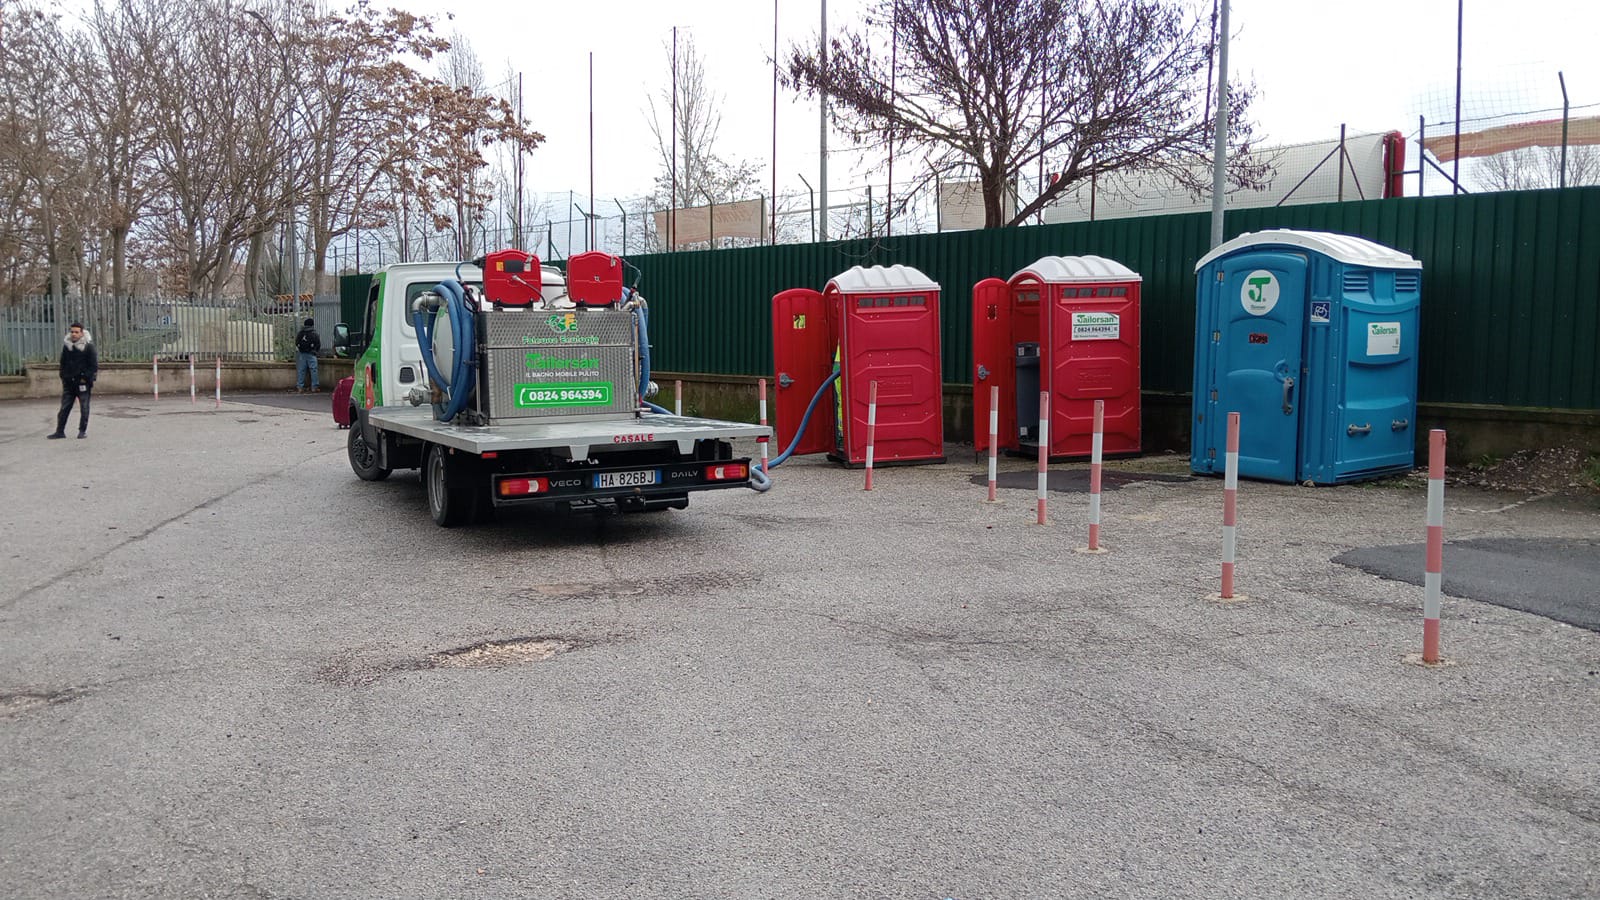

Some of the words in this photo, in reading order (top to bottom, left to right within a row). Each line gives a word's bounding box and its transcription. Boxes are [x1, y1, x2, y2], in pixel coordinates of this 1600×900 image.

[1077, 315, 1114, 323] Tailorsan
[525, 353, 599, 369] Tailorsan
[529, 391, 559, 401] 0824
[561, 390, 602, 400] 964394
[613, 434, 654, 444] CASALE
[601, 474, 615, 487] HA
[619, 472, 655, 485] 826BJ
